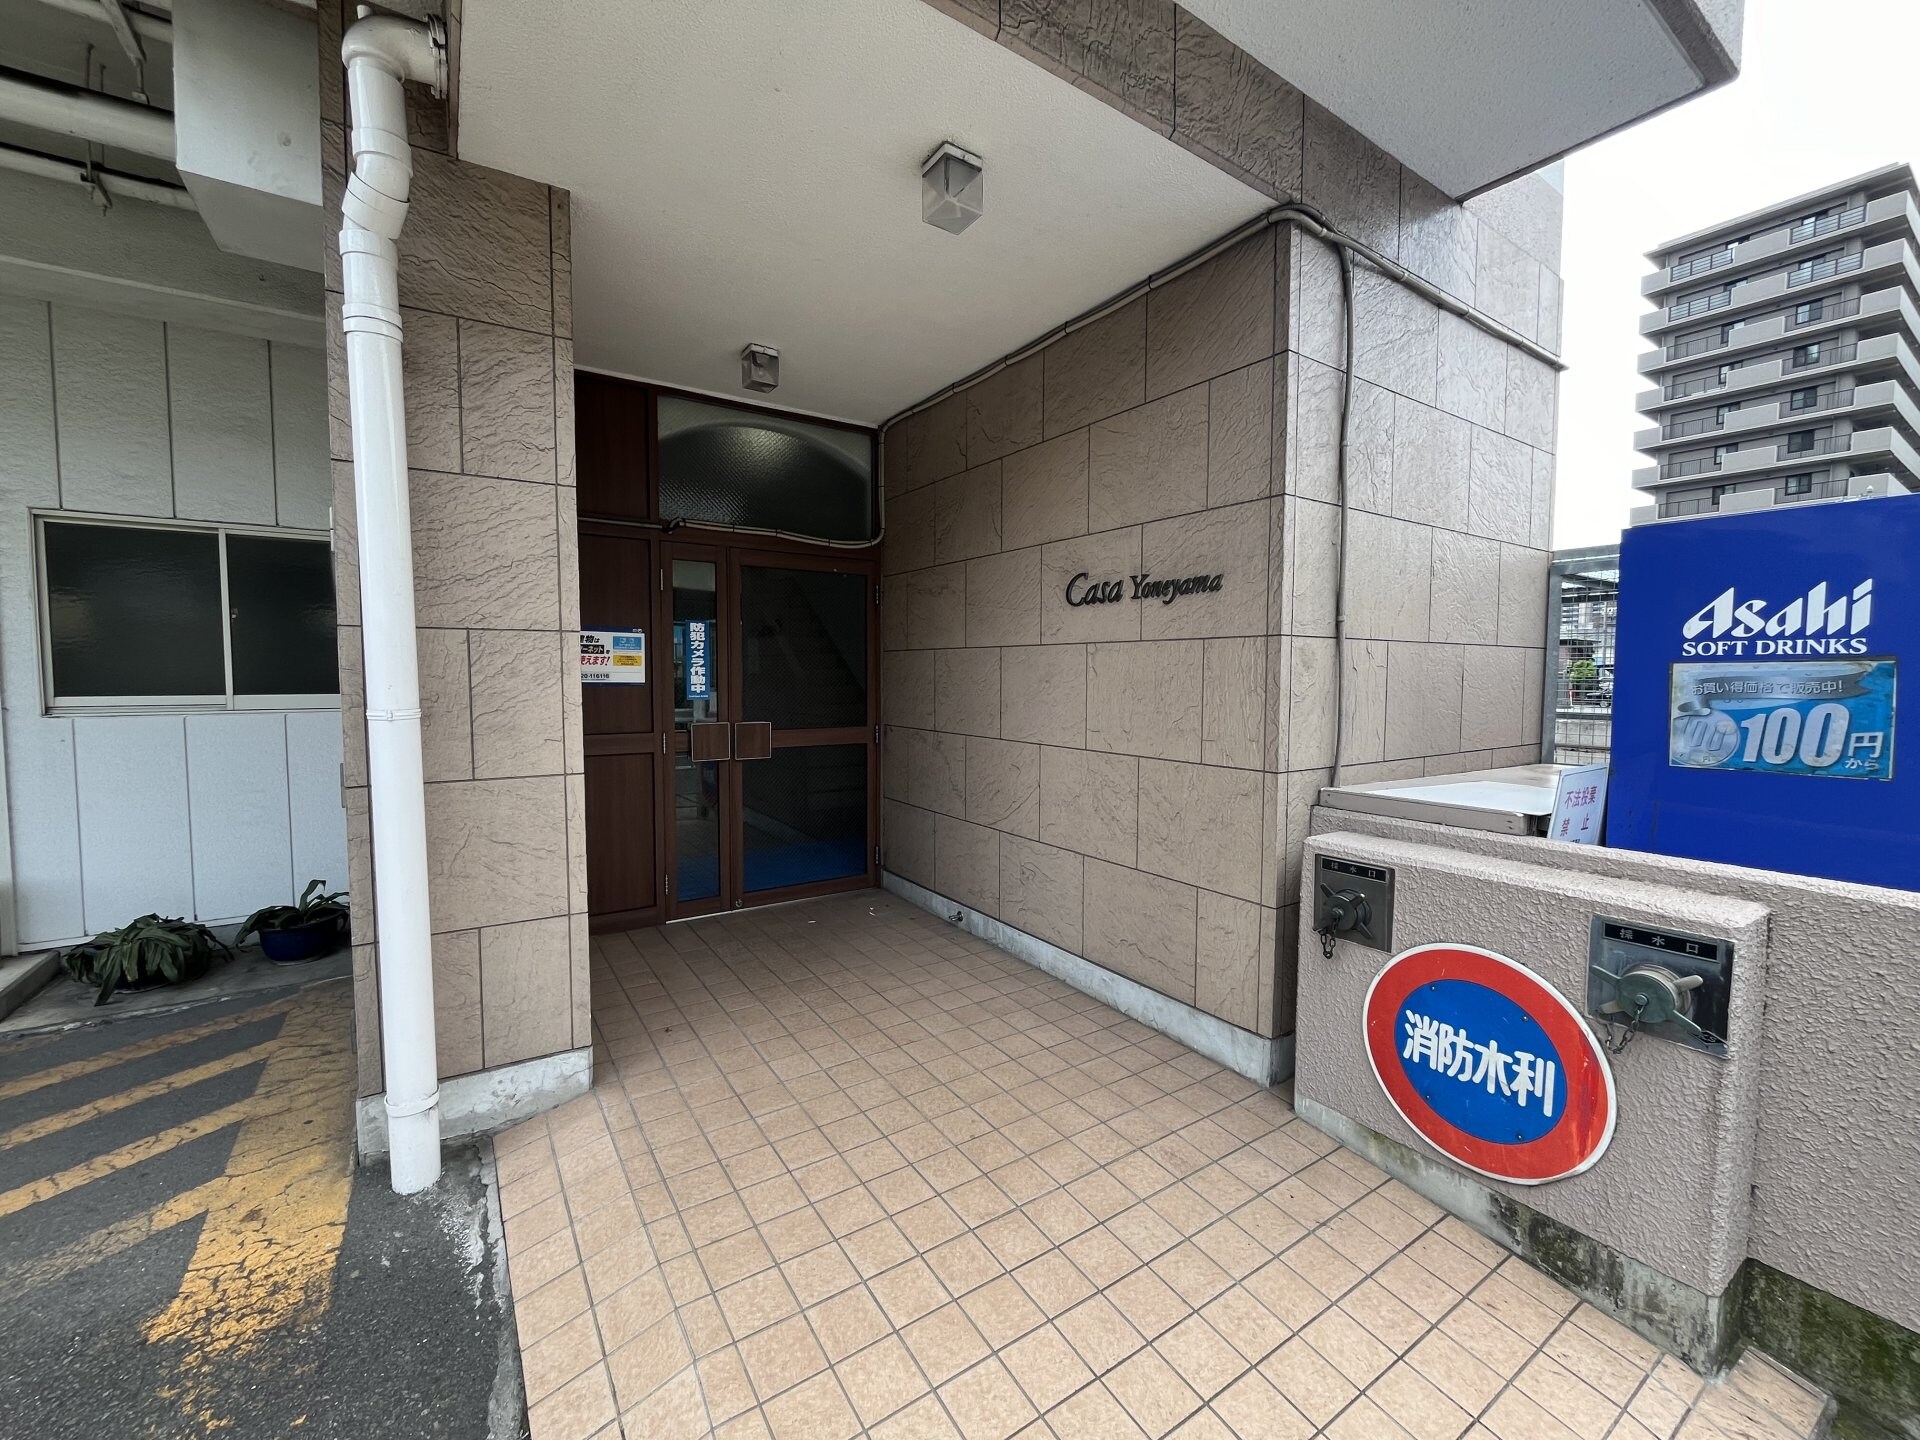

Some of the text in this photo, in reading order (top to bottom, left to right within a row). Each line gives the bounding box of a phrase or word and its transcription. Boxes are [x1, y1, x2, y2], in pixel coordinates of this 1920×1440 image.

[1066, 573, 1224, 607] Casa Yoneyama
[1682, 578, 1873, 640] Asahi
[689, 622, 706, 694] 防犯カメラ作動中
[1682, 638, 1868, 656] SOFT DRINKS
[1691, 680, 1843, 696] お買い得価格で販売中!
[1845, 757, 1880, 771] から
[1620, 928, 1699, 954] 採水口
[1403, 1009, 1555, 1117] 消防水利
